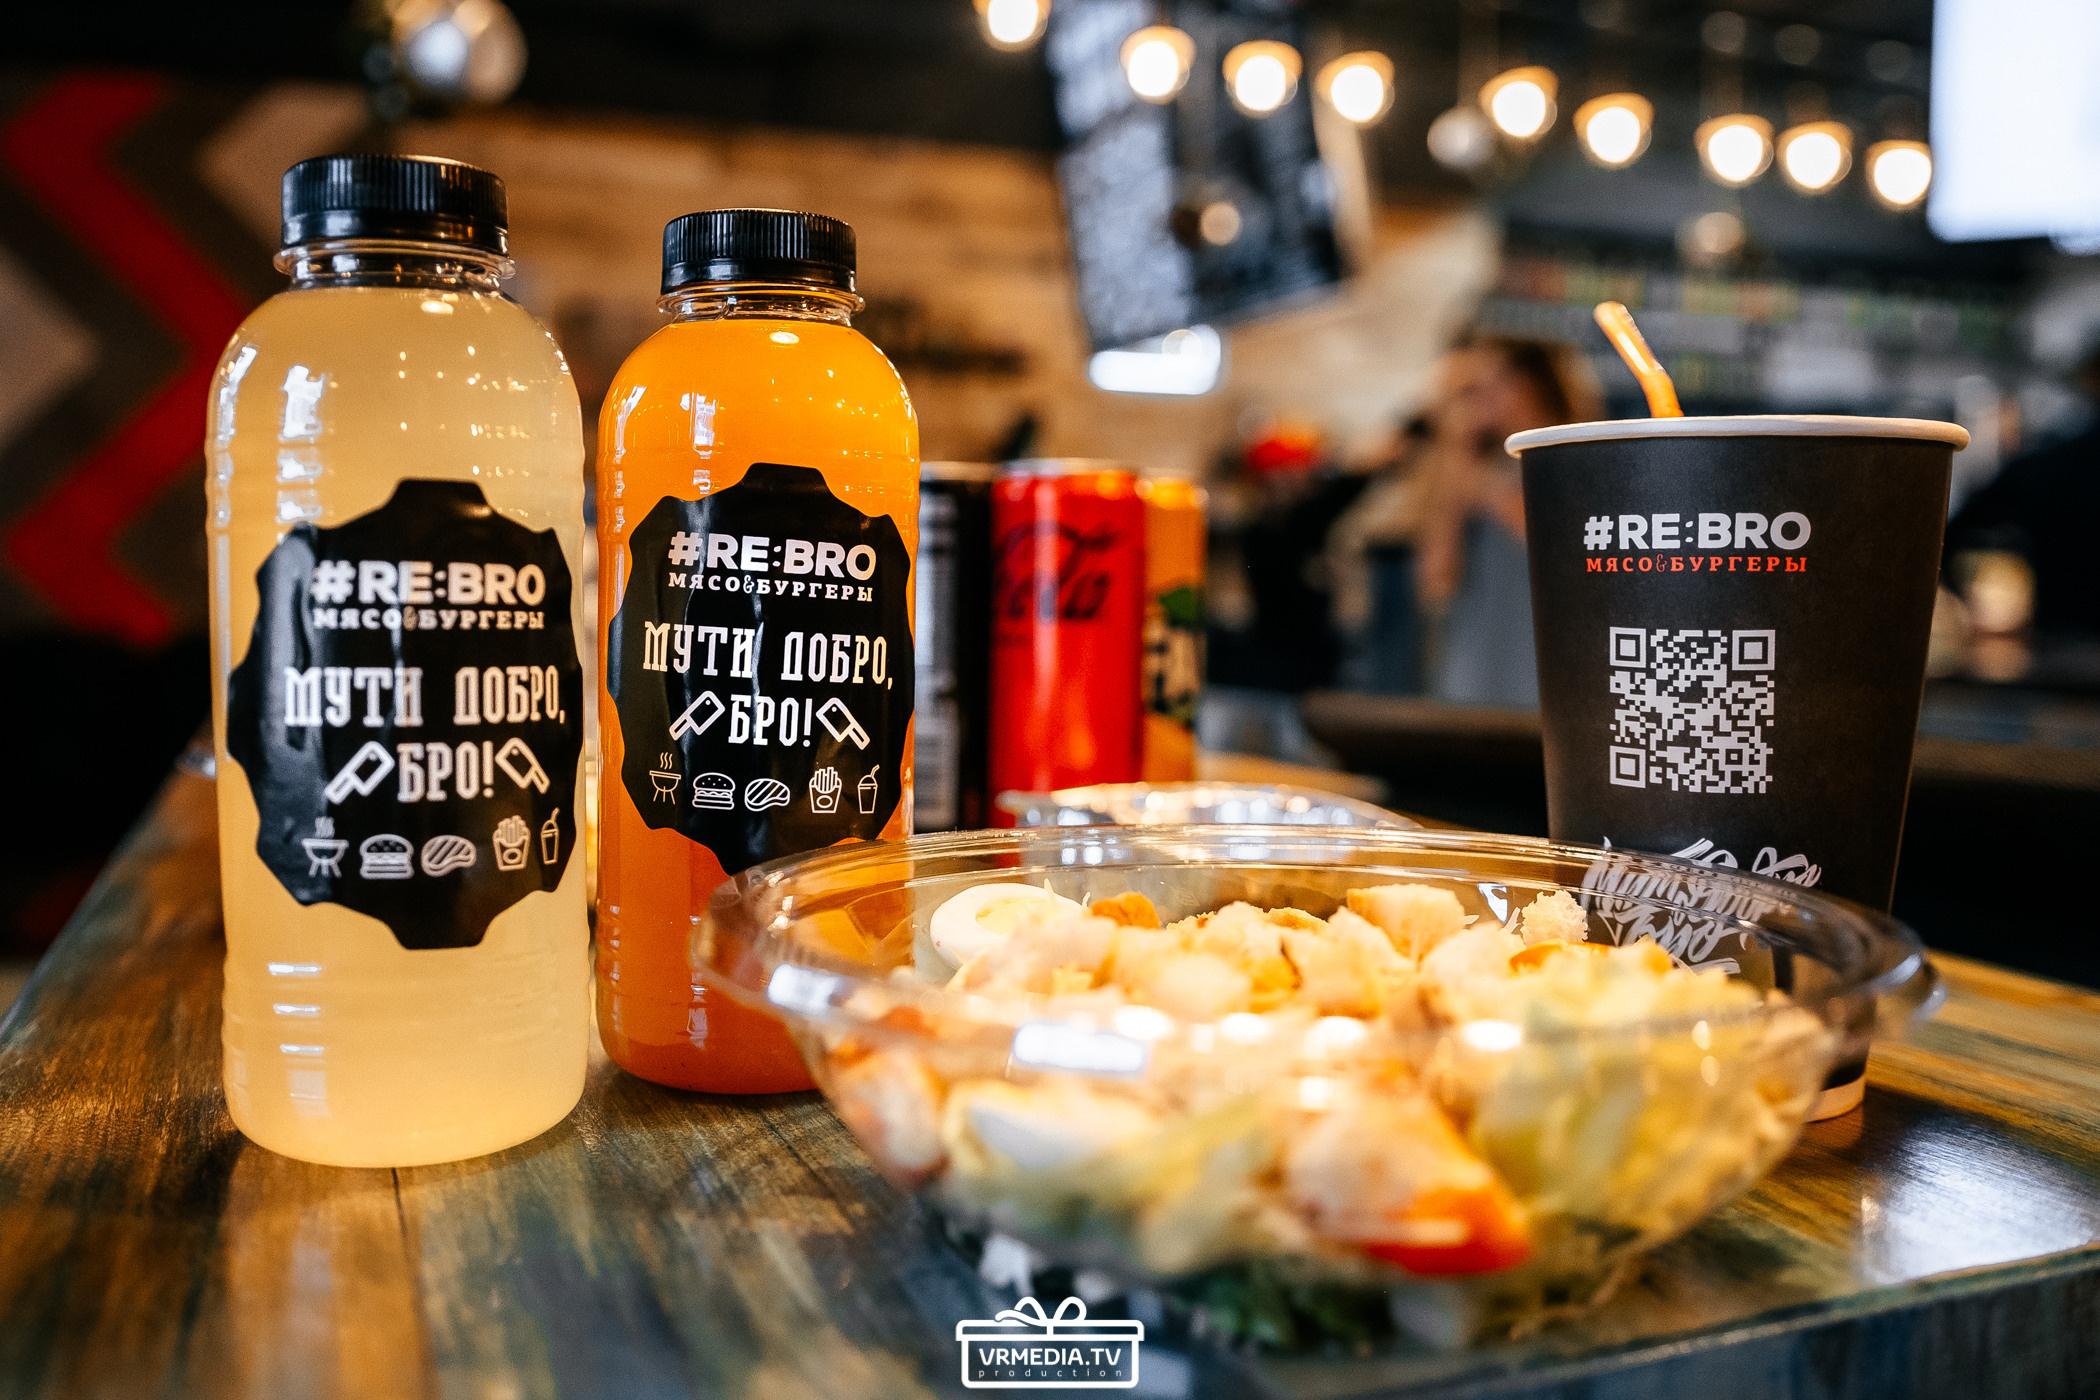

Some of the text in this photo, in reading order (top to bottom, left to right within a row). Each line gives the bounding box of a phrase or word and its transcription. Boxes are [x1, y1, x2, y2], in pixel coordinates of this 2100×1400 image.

[1583, 511, 1812, 550] #RE:BRO
[667, 531, 877, 581] #RE:BRO
[1586, 553, 1808, 573] МЯСО&БУРГЕРЫ
[309, 558, 547, 606] #RE:BRO
[668, 572, 873, 602] МЯСО&БУРГЕРЫ
[642, 620, 893, 690] МУТИ ДОБРО,
[284, 664, 566, 727] МУТИ ДОБРО,
[728, 693, 813, 748] БРО!
[396, 740, 495, 802] БРО!
